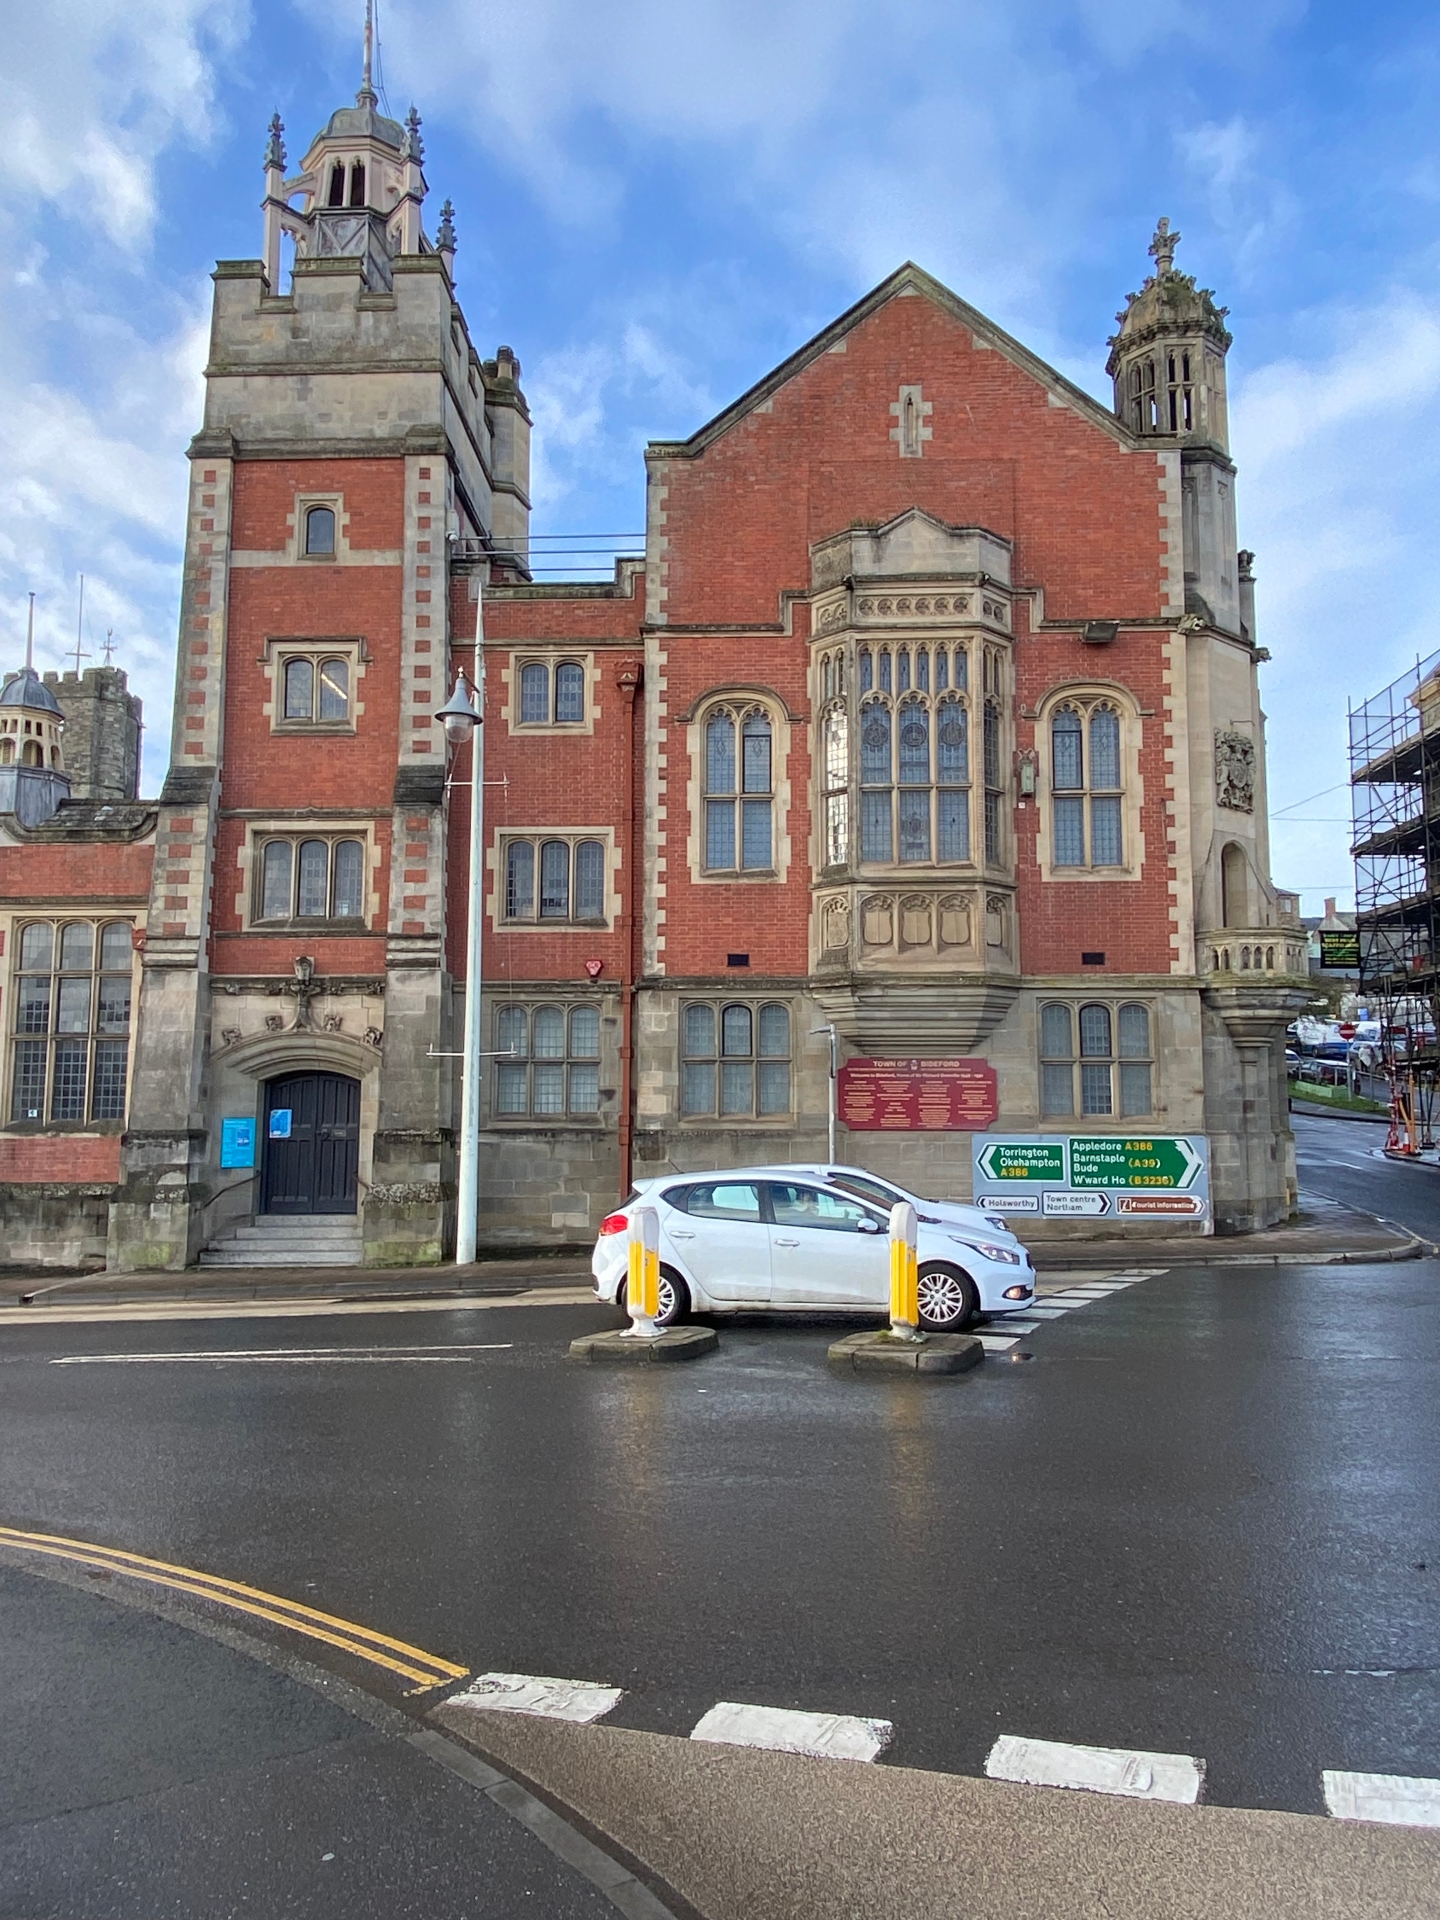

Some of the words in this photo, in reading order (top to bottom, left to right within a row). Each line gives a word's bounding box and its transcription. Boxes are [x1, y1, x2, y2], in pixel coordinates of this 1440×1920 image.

[872, 1060, 897, 1068] TOWN
[897, 1060, 908, 1068] OF
[920, 1060, 960, 1068] BIDEFORD
[1072, 1141, 1122, 1152] Appledore
[999, 1147, 1049, 1159] Torrington
[999, 1157, 1061, 1169] Okehampton
[1073, 1153, 1126, 1164] Barnstaple
[1000, 1167, 1029, 1177] A386
[1073, 1163, 1099, 1173] Bude
[1111, 1175, 1126, 1185] Ho
[988, 1199, 1036, 1209] Holsworthy
[1046, 1195, 1067, 1203] Town
[1069, 1195, 1096, 1203] centre
